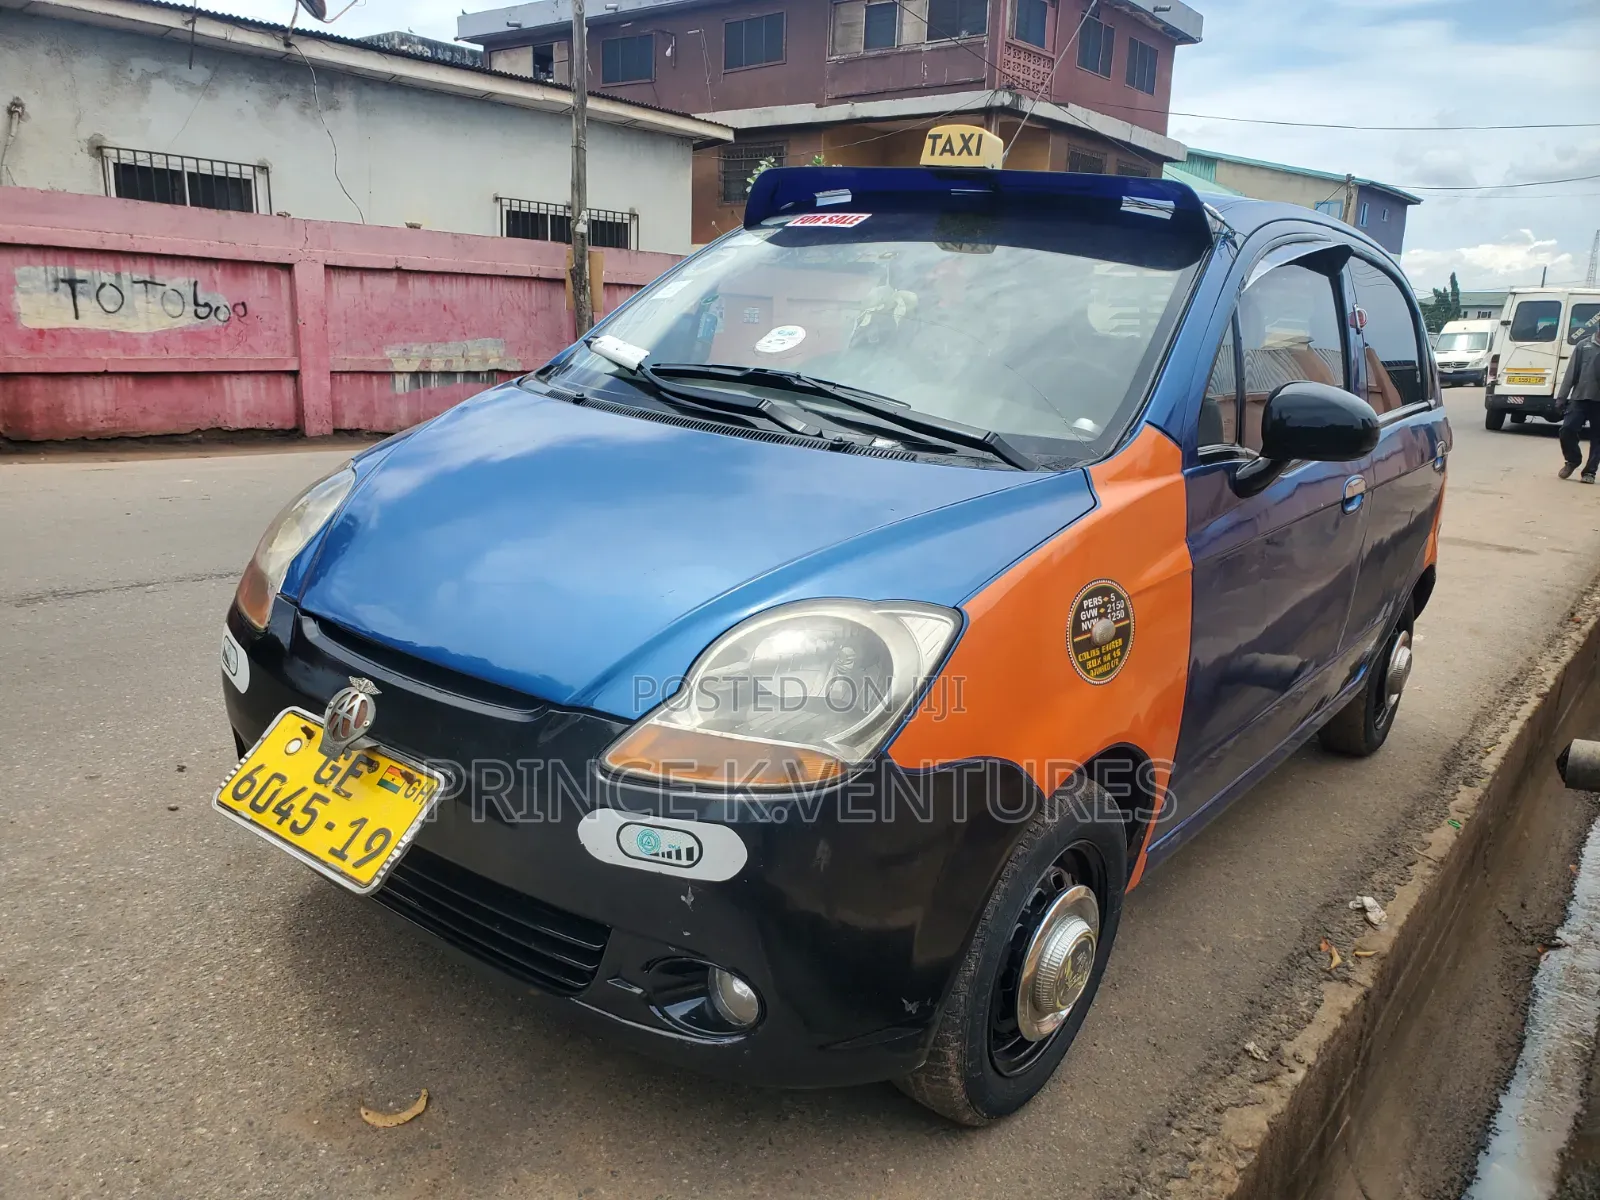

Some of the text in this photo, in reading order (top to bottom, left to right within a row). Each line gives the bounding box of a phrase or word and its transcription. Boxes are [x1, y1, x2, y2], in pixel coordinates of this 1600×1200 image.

[928, 134, 983, 156] TAXI
[792, 215, 865, 225] FOR SALE
[1080, 600, 1125, 621] GVW 2150
[1083, 593, 1116, 609] PERS 5
[313, 750, 373, 801] GE
[404, 778, 434, 806] GH
